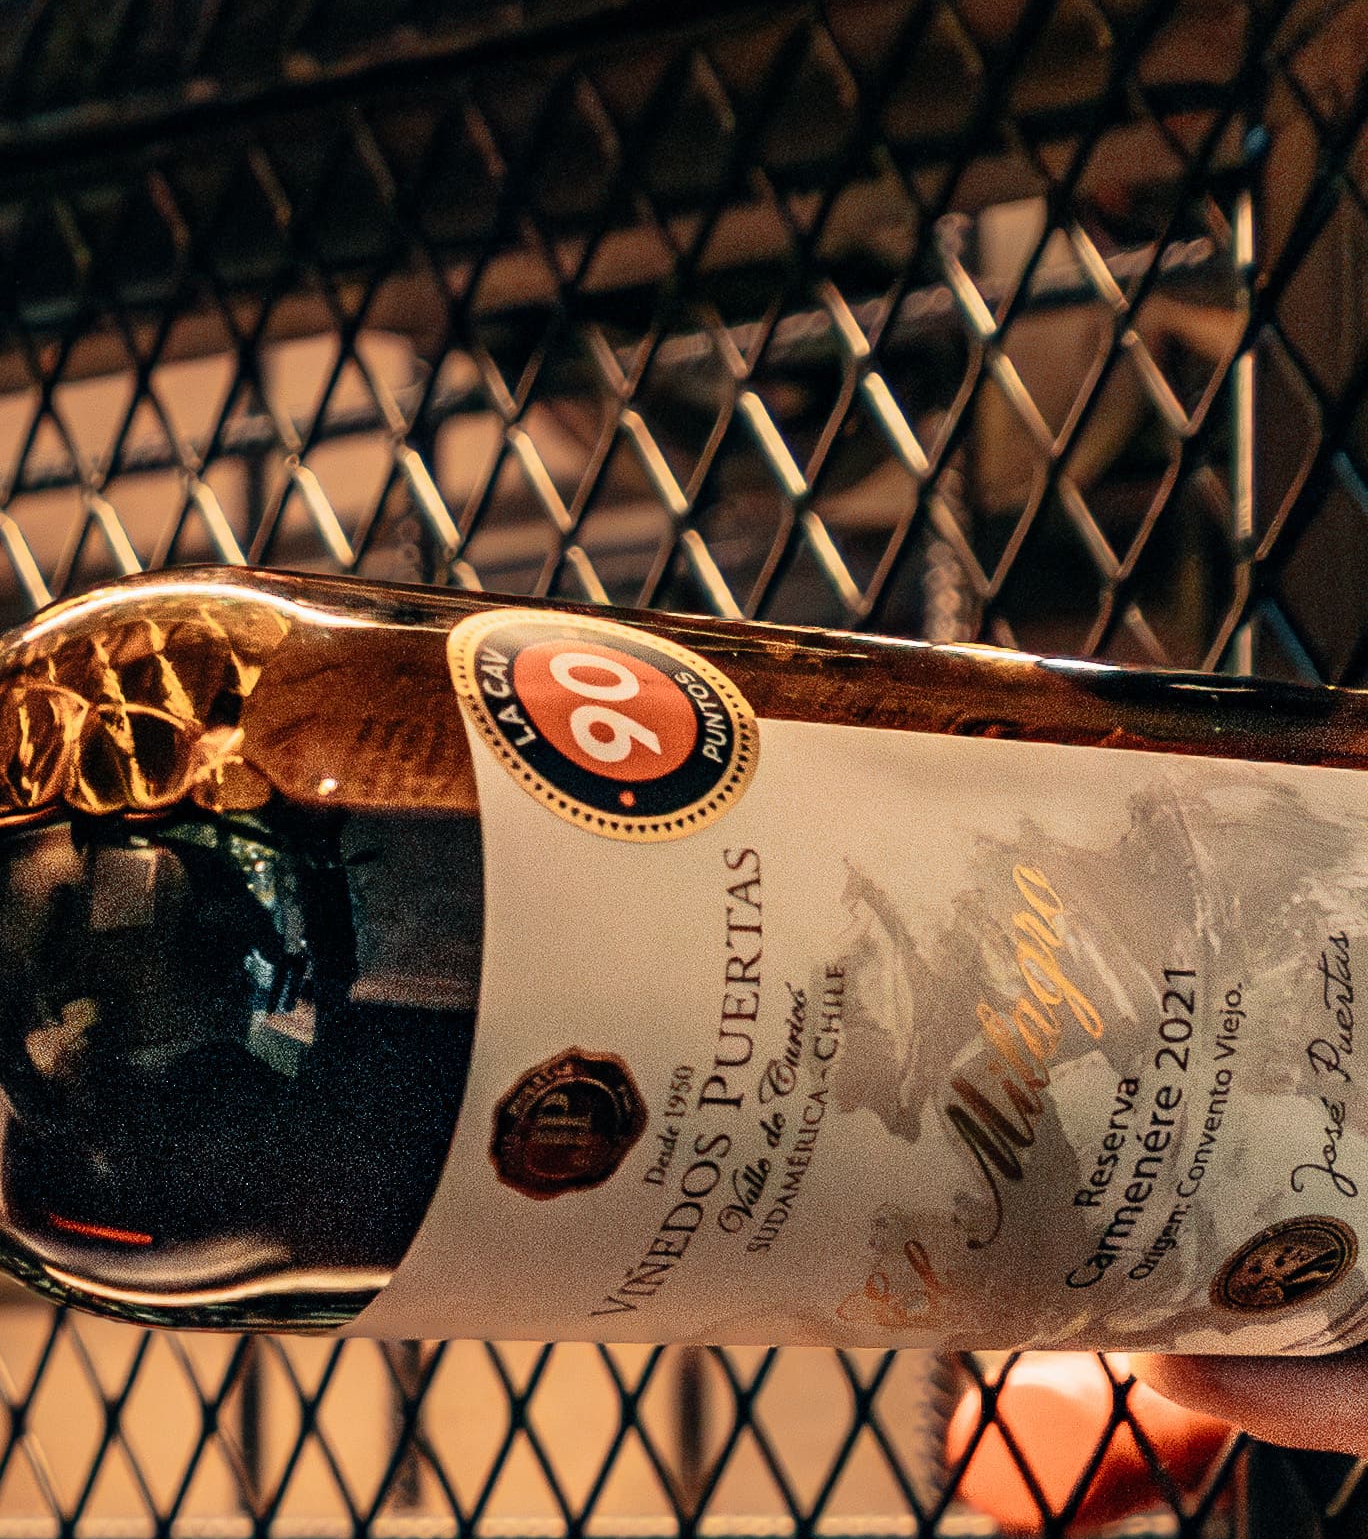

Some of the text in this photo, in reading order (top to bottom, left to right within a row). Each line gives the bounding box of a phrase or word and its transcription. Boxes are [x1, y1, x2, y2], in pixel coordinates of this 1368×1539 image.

[480, 645, 538, 748] LA CAV
[549, 651, 662, 763] 90
[674, 671, 729, 763] PUNTOS
[590, 847, 764, 1316] VIÑEDOS PUERTAS
[717, 981, 808, 1234] Valle de Curicó
[746, 1088, 829, 1253] SUDAMÉRICA
[814, 963, 847, 1062] CHILE
[946, 863, 1104, 1250] Milagro
[1155, 967, 1197, 1073] 2021
[1290, 929, 1360, 1199] José Puertas
[643, 1064, 696, 1187] Desde 1950
[1073, 1076, 1140, 1209] Reserva
[1127, 981, 1248, 1281] Origen: Convento Viejo.
